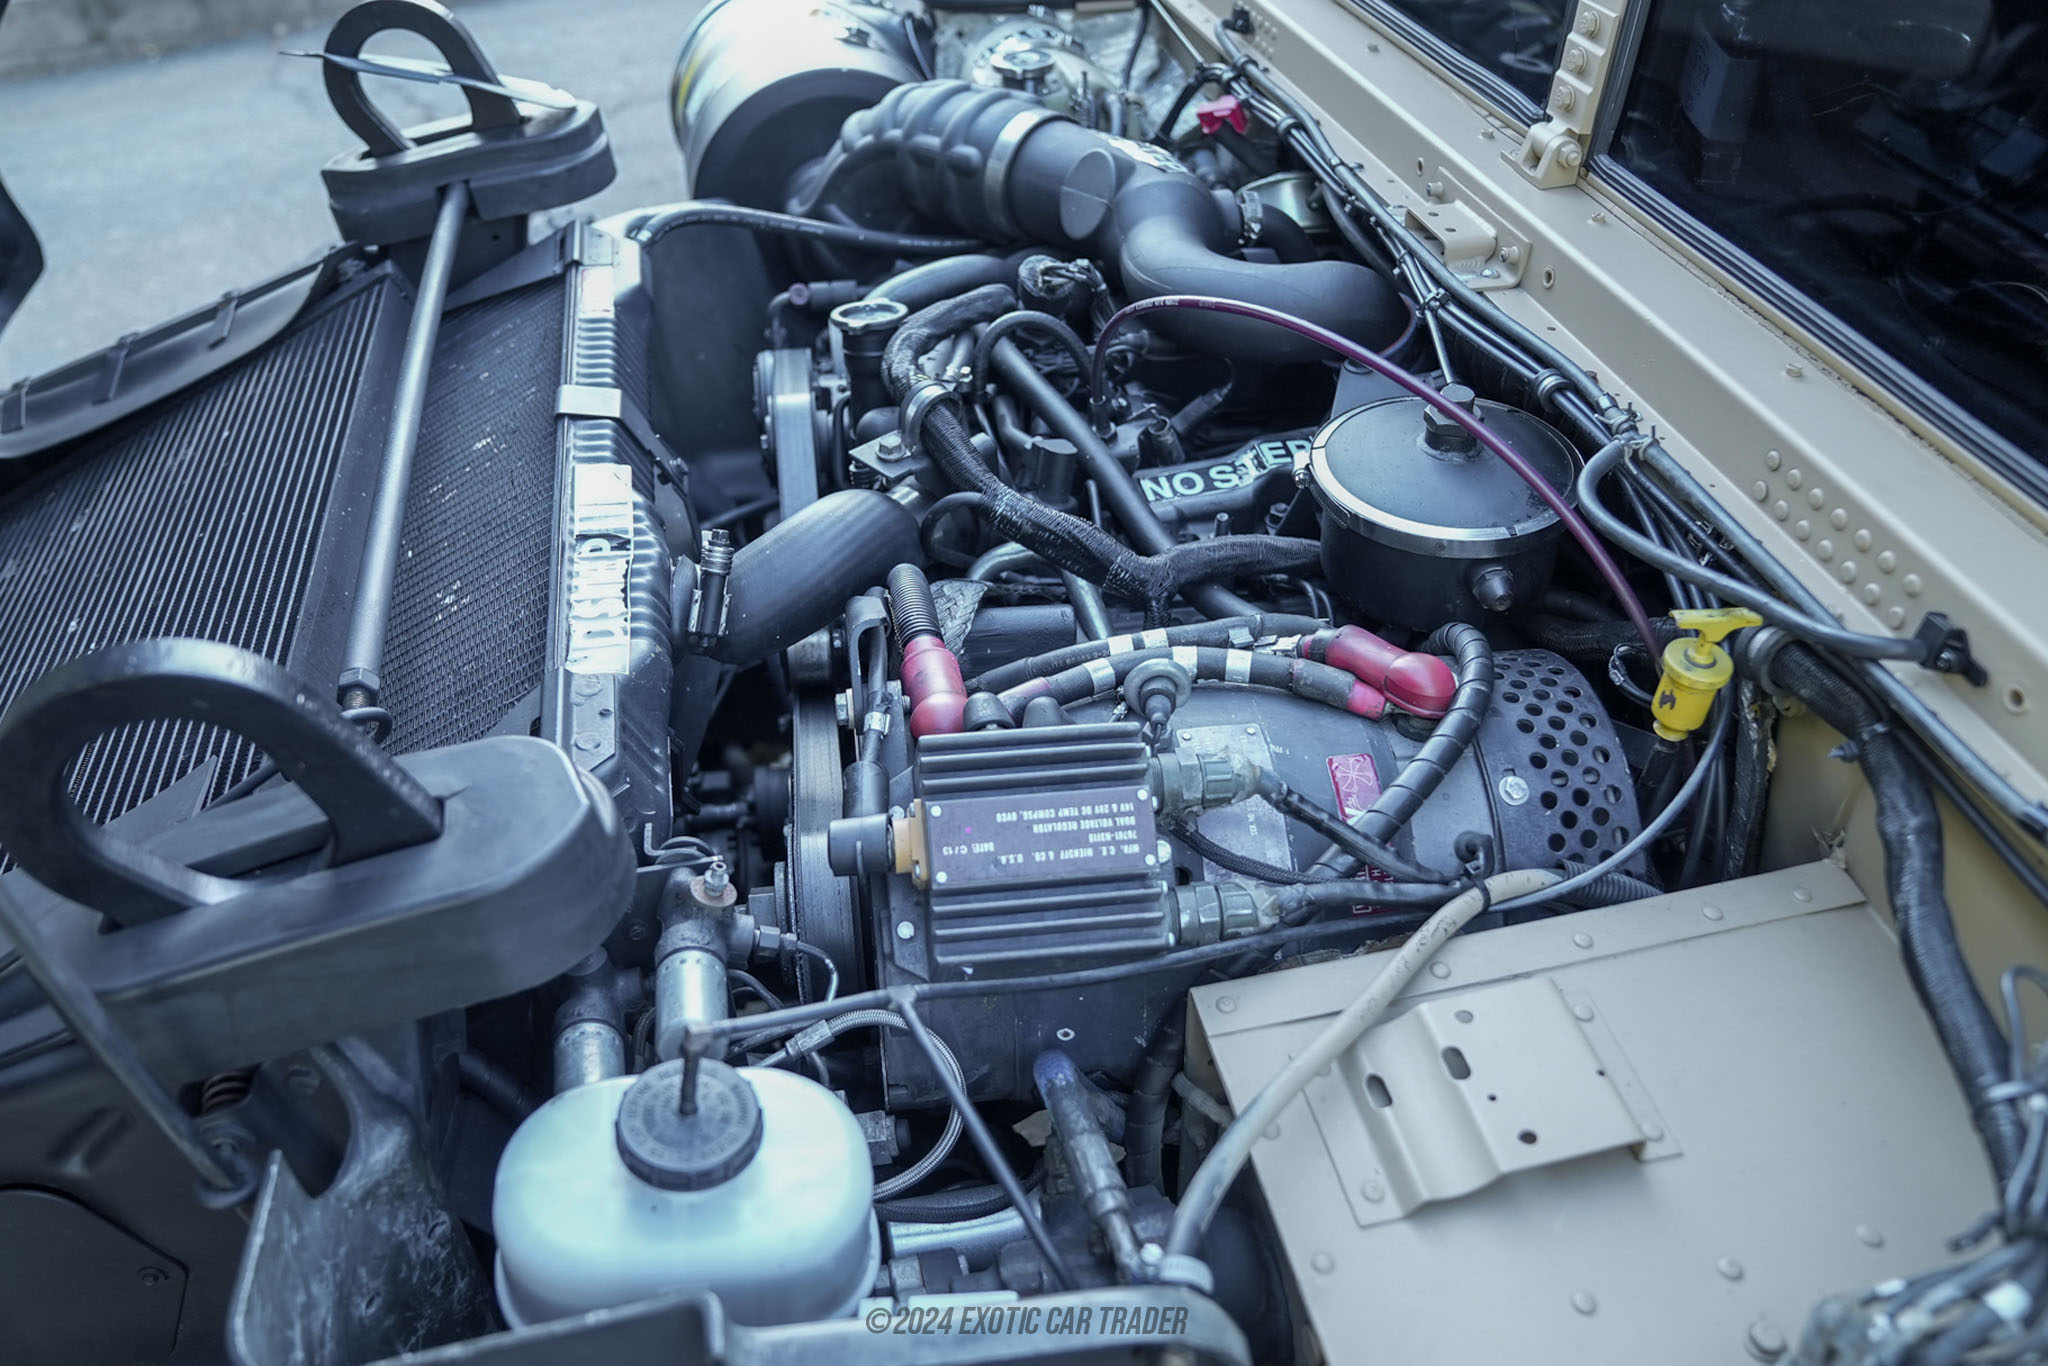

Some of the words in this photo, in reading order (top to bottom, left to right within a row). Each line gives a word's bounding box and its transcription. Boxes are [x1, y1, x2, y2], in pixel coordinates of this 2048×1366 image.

[1139, 470, 1206, 503] NO
[1058, 806, 1079, 818] TEMP
[1080, 805, 1093, 816] DC
[1119, 801, 1134, 812] 14V
[1032, 820, 1078, 834] REGULATOR
[1080, 817, 1114, 830] VOLTAGE
[1114, 815, 1136, 827] DUAL
